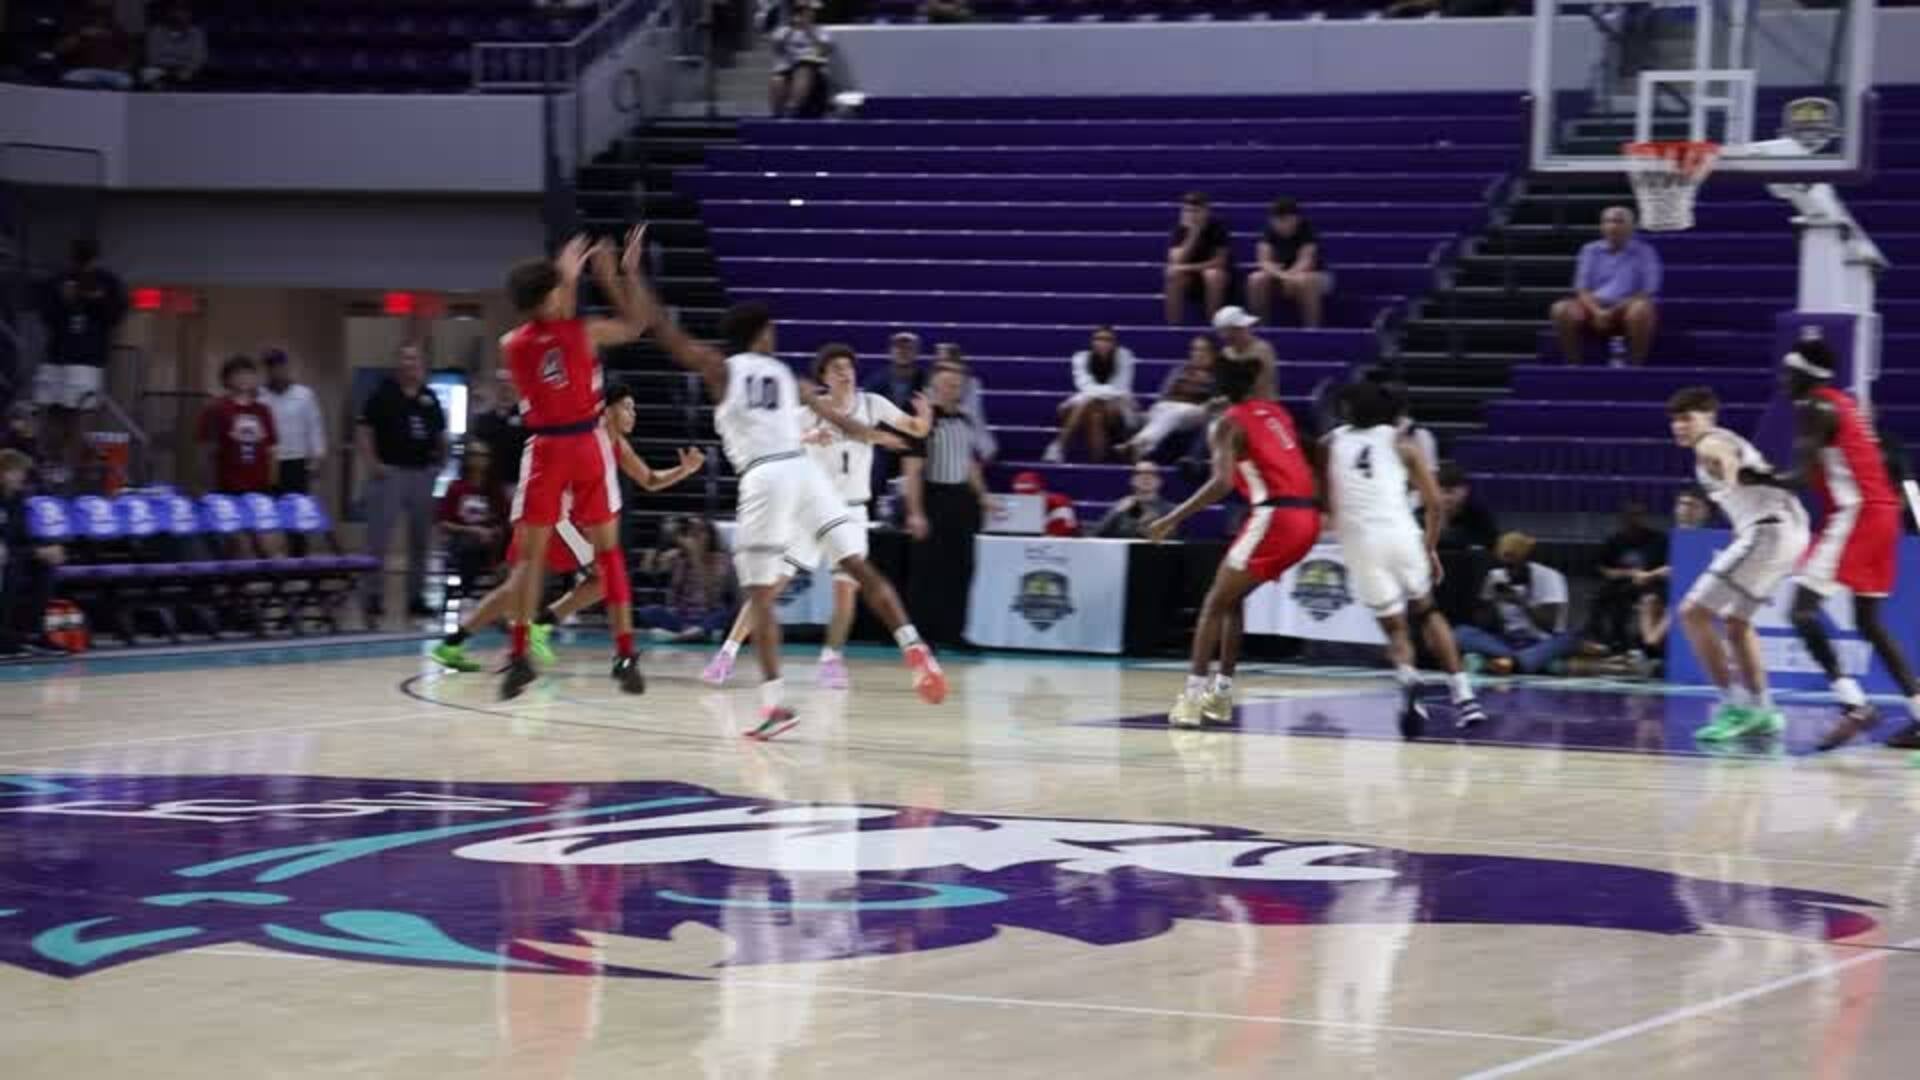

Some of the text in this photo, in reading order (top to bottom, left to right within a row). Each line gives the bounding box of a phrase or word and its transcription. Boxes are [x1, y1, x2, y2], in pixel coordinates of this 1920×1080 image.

[541, 346, 570, 391] 4
[745, 374, 780, 410] 10
[841, 450, 851, 475] 1
[1353, 444, 1374, 479] 4
